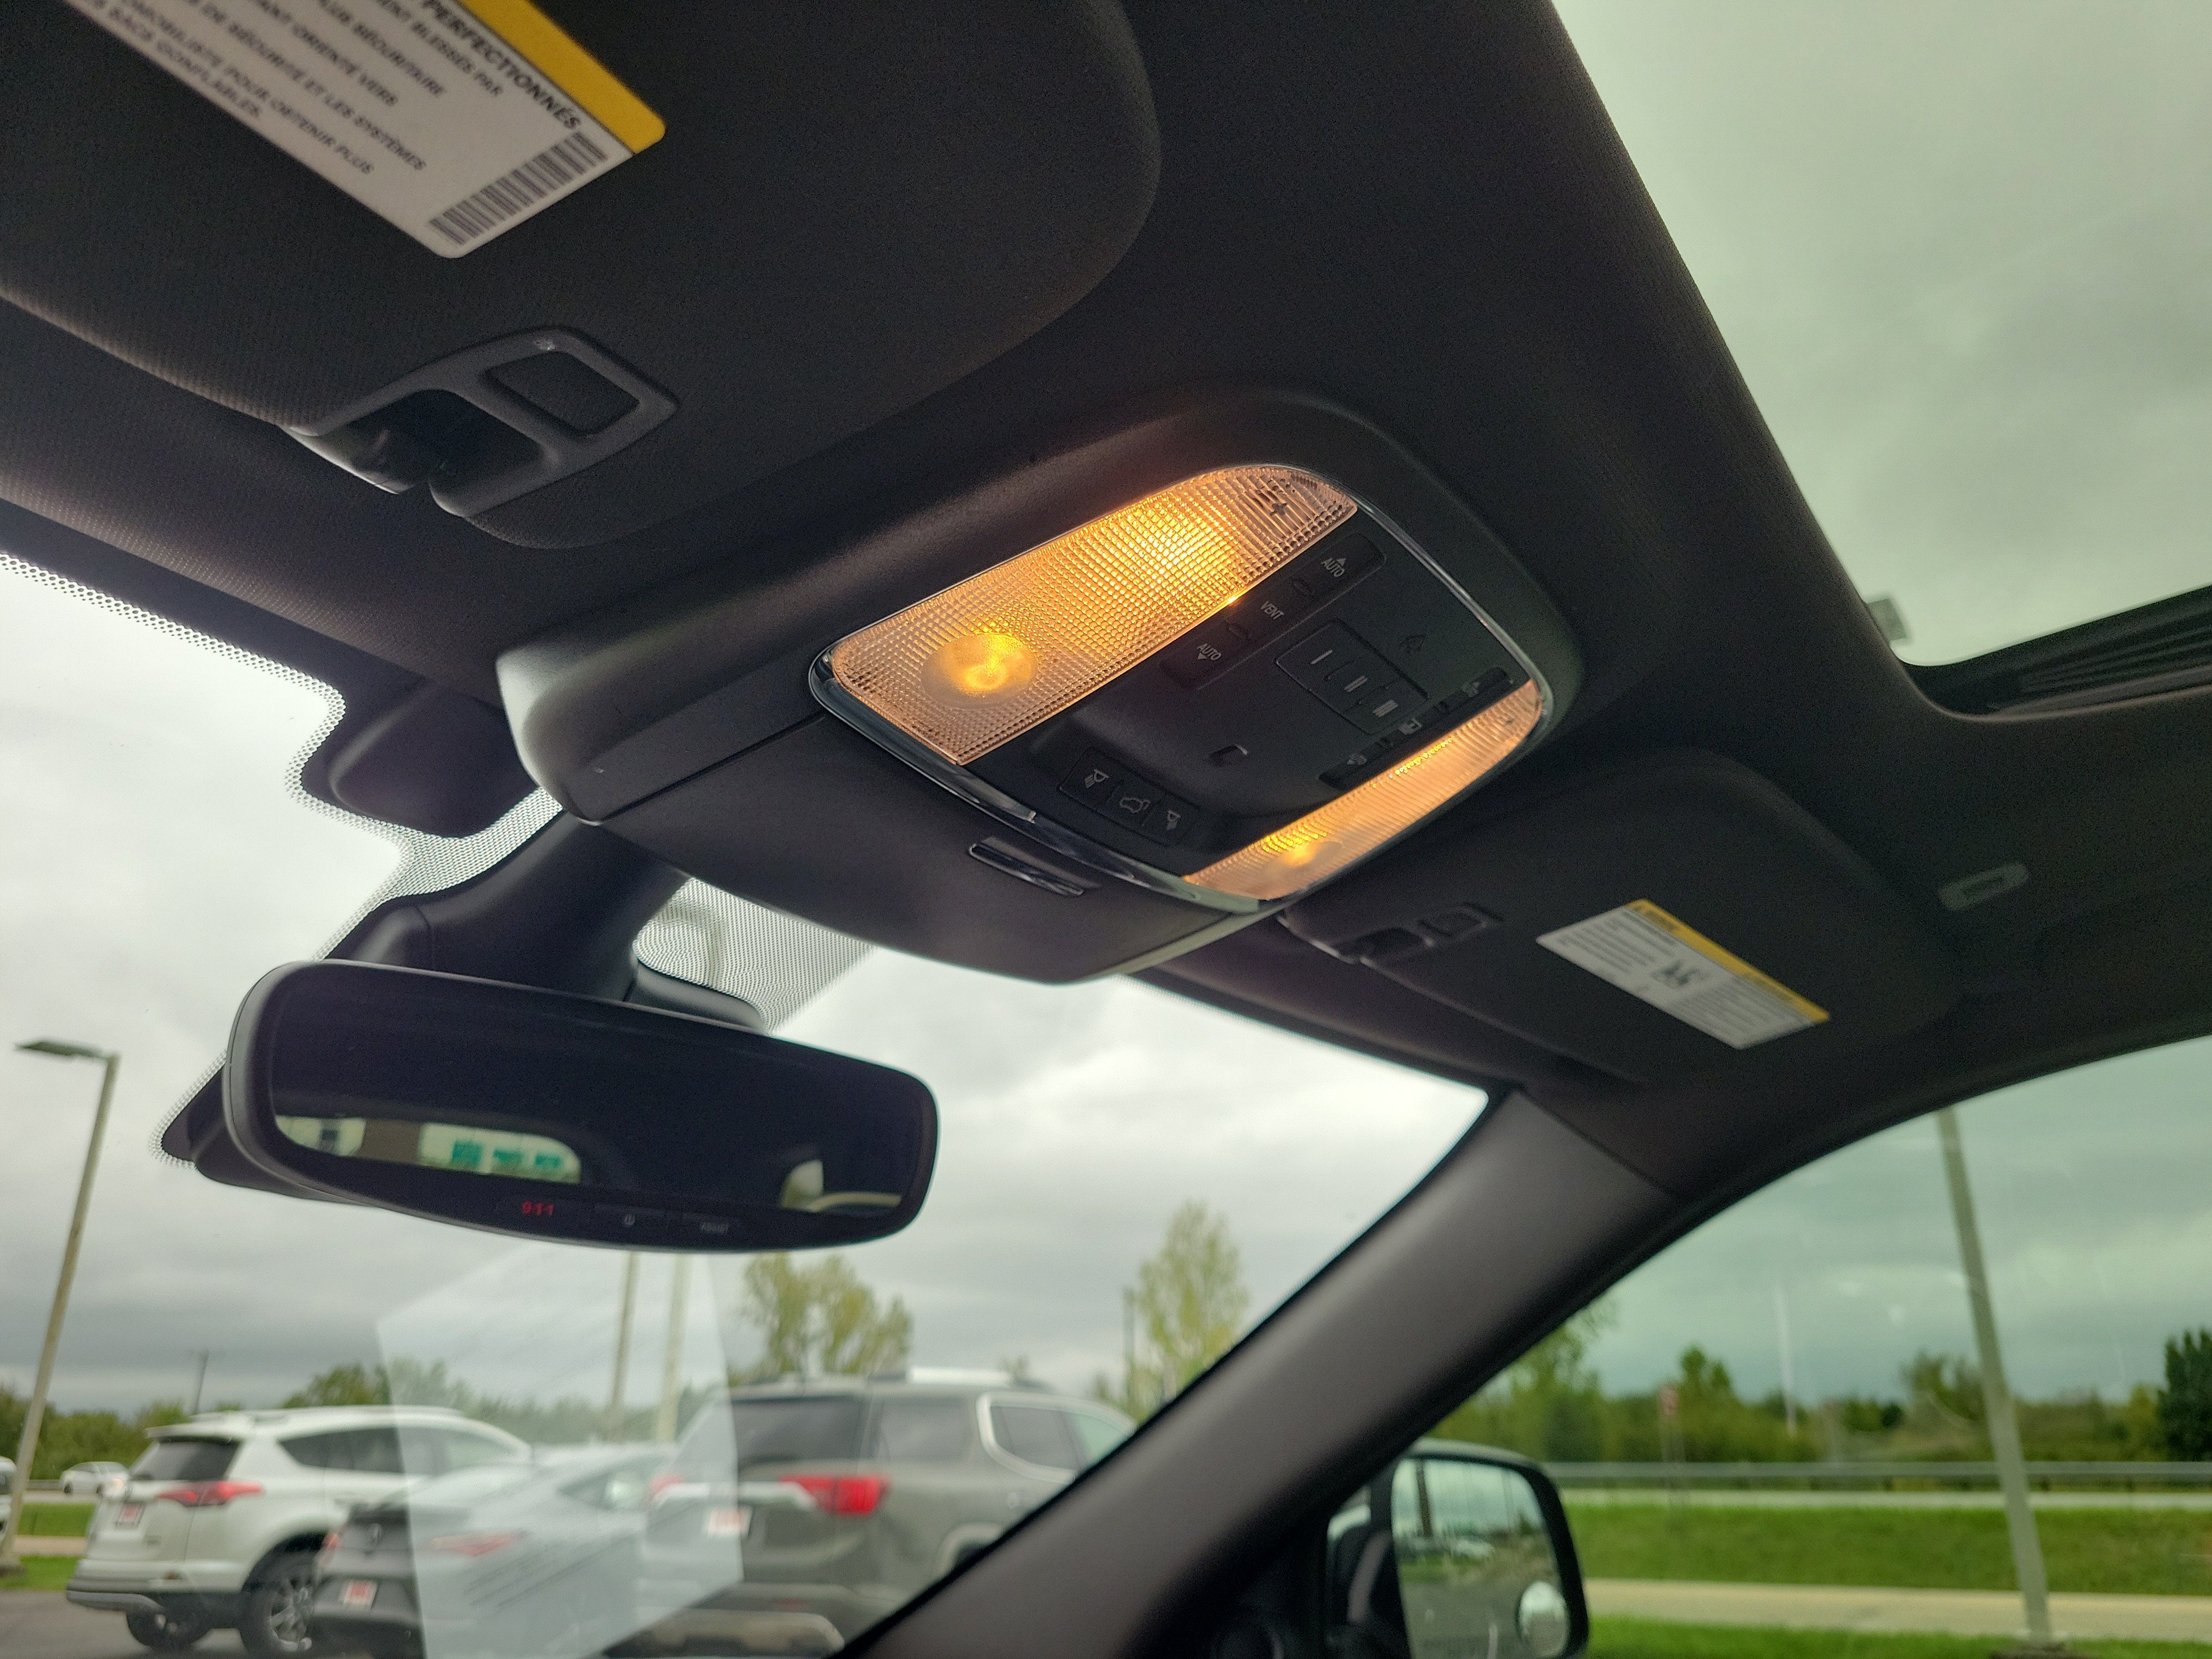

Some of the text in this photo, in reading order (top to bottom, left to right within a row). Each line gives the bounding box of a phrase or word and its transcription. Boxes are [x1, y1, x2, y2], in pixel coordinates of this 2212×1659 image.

[423, 0, 582, 129] PERFECTIONNÉS
[474, 70, 503, 98] PAR
[334, 144, 376, 175] PLUS
[1321, 557, 1345, 577] AUTO
[1261, 600, 1284, 620] VENT
[1195, 643, 1222, 661] AUTO
